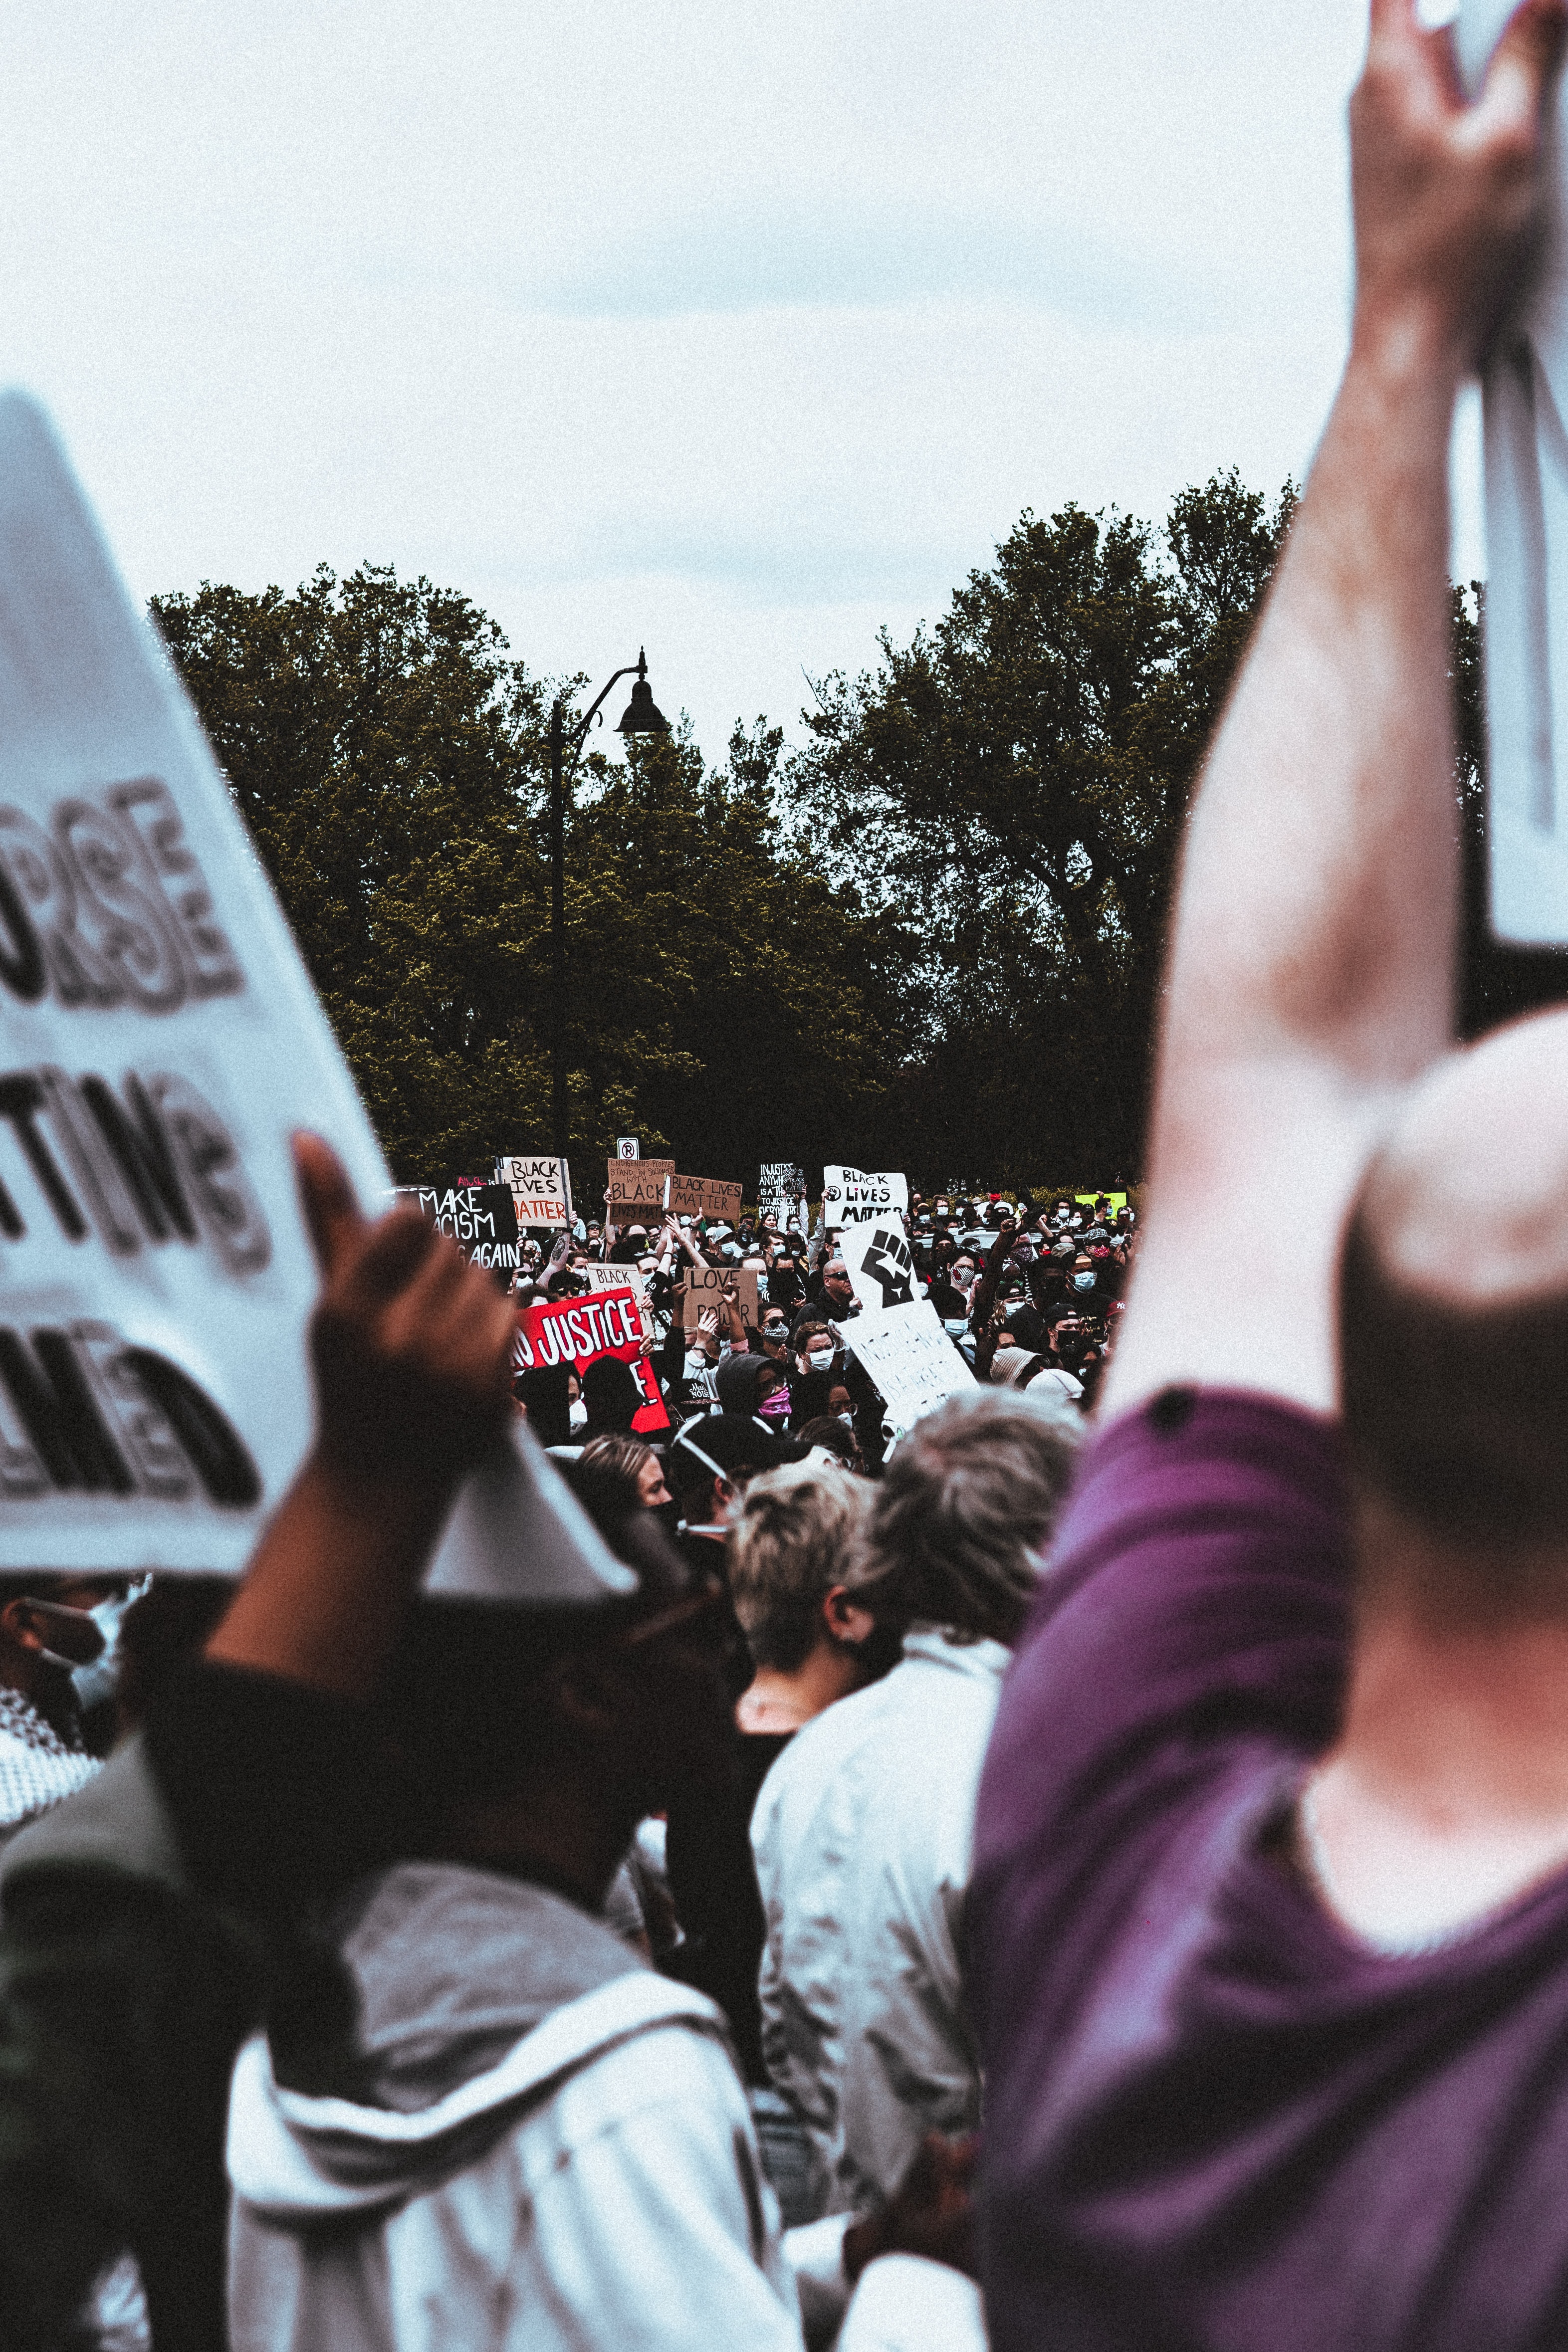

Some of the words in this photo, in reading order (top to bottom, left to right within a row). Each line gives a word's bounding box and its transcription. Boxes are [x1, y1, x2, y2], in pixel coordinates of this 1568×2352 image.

[0, 1064, 272, 1281] TING
[511, 1161, 559, 1179] BLACK
[843, 1170, 889, 1185] BLACK
[504, 1179, 557, 1193] IVES
[672, 1176, 705, 1192] BLACK
[711, 1181, 741, 1197] LIVES
[759, 1175, 784, 1186] ANYWH
[419, 1187, 482, 1215] MAKE
[612, 1182, 665, 1201] BLACK
[675, 1192, 728, 1211] MATTER
[771, 1197, 795, 1206] JUSCE
[432, 1211, 495, 1240] ACISM
[468, 1243, 520, 1270] AGAIN
[598, 1270, 631, 1284] BLACK
[690, 1269, 740, 1289] LOVE
[697, 1303, 750, 1326] POWR
[537, 1297, 641, 1365] JUSTICE
